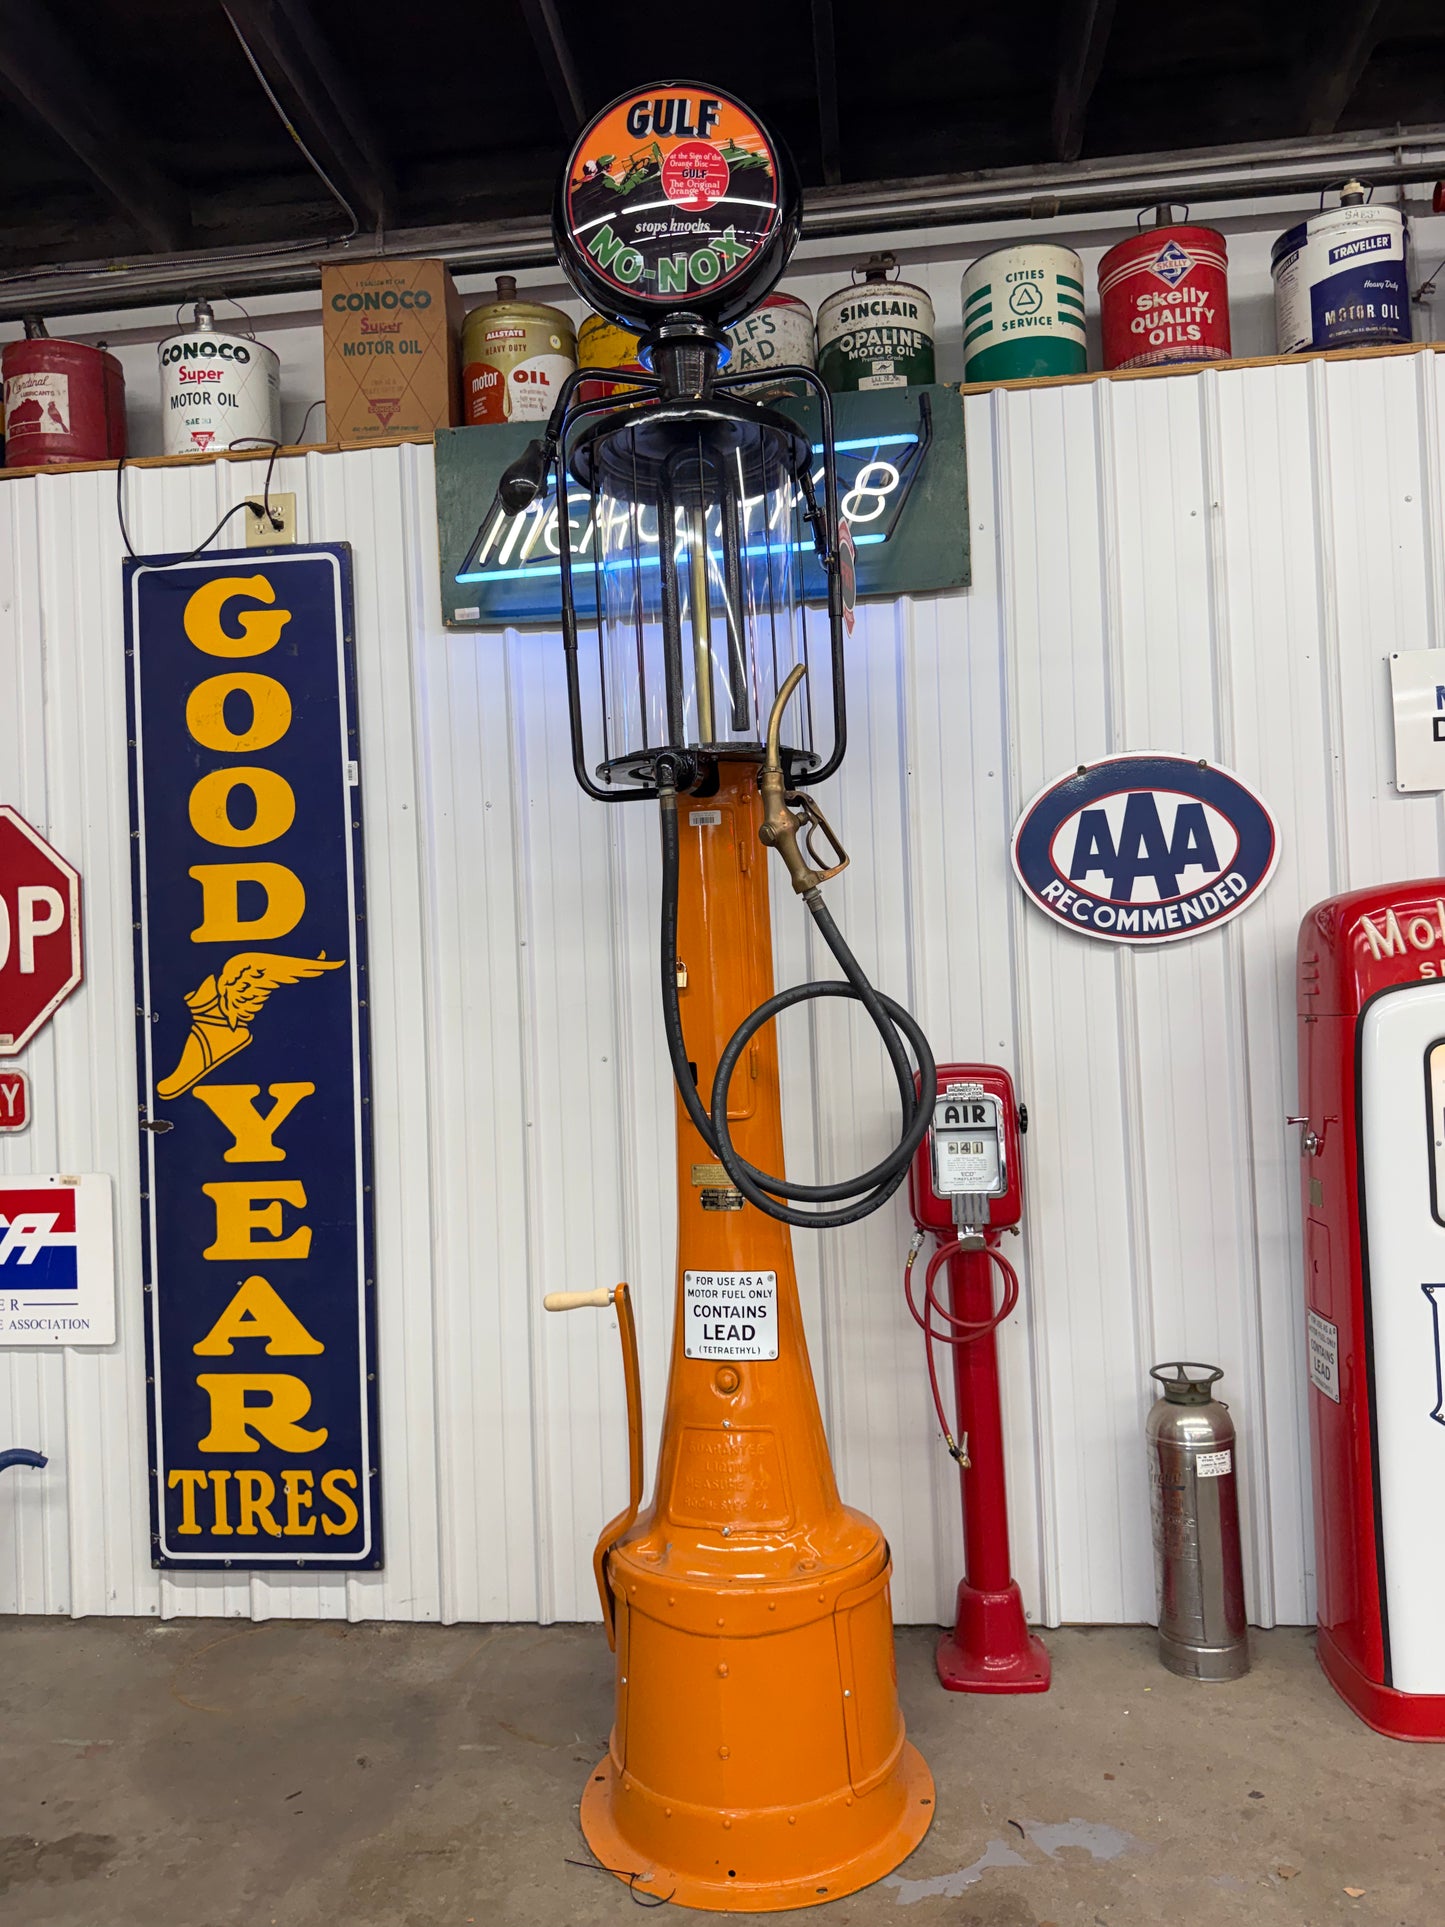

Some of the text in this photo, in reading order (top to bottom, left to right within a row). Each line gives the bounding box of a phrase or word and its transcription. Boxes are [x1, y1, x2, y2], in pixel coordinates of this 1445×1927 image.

[626, 99, 722, 139] GULF
[669, 160, 709, 169] Orange Disc
[682, 169, 709, 180] GULF
[669, 179, 720, 191] The Original
[669, 187, 721, 198] Orange Gas
[635, 218, 711, 235] stops knocks
[1333, 236, 1389, 260] TRAVELLER
[587, 224, 752, 293] NO-NOX
[1155, 259, 1188, 270] SKELLY
[1006, 269, 1044, 284] CITIES
[1364, 280, 1399, 292] Heavy Duty
[331, 290, 432, 313] CONOCO
[1137, 287, 1209, 312] Skelly
[840, 300, 918, 323] SINCLAIR
[1130, 307, 1215, 334] QUALITY
[1325, 303, 1400, 326] MOTOR OIL
[360, 317, 403, 336] Super
[732, 313, 776, 346] LF'S
[1002, 316, 1053, 332] SERVICE
[486, 329, 524, 341] ALLSTATE
[839, 328, 922, 353] OPALINE
[1149, 325, 1202, 346] OILS
[161, 341, 251, 366] CONOCO
[343, 340, 423, 357] MOTOR OIL
[485, 344, 527, 357] HEAVY DUTY
[848, 345, 916, 361] MOTOR OIL
[178, 365, 224, 385] Super
[472, 371, 499, 394] motor
[513, 369, 550, 386] OIL
[12, 375, 52, 395] Cardinal
[20, 390, 55, 398] LUBRICANTS
[170, 391, 239, 410] MOTOR OIL
[185, 418, 200, 426] SAE
[1069, 792, 1221, 902] AAA
[1041, 872, 1248, 932] RECOMMENDED
[1360, 900, 1445, 960] Mo
[945, 1104, 986, 1124] AIR
[696, 1276, 764, 1286] FOR USE AS A
[687, 1288, 773, 1299] MOTOR FUEL ONLY
[693, 1304, 767, 1319] CONTAINS
[9, 1319, 90, 1330] ASSOCIATION
[703, 1323, 756, 1341] LEAD
[1311, 1339, 1334, 1365] CONTAINS
[1314, 1356, 1331, 1381] LEAD
[167, 1469, 359, 1536] TIRES
